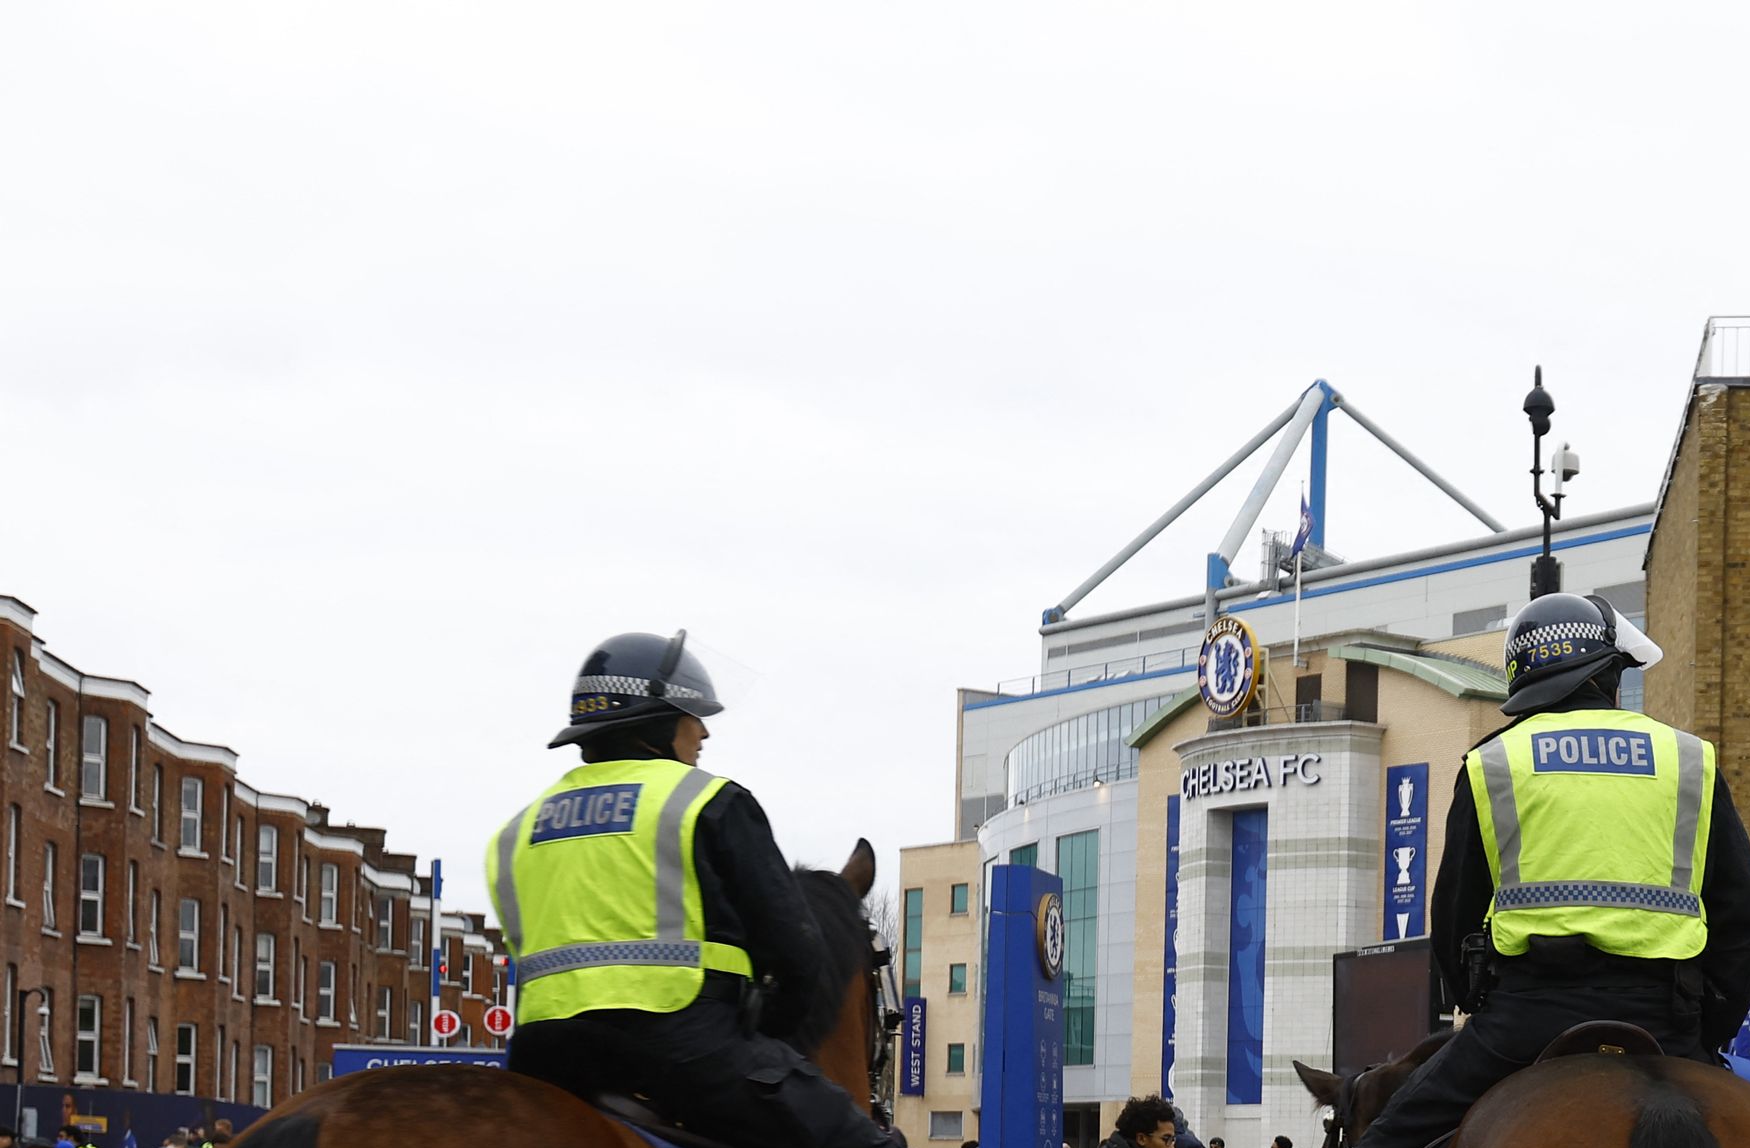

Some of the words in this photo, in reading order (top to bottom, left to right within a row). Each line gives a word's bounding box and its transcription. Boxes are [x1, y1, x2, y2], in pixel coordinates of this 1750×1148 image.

[1206, 619, 1243, 644] CHELSEA
[1527, 641, 1573, 663] 7535
[1538, 736, 1648, 767] POLICE
[1181, 757, 1271, 799] CHELSEA
[1279, 752, 1321, 786] FC
[534, 791, 634, 833] POLICE
[911, 1004, 922, 1048] STAND
[911, 1051, 920, 1088] WEST
